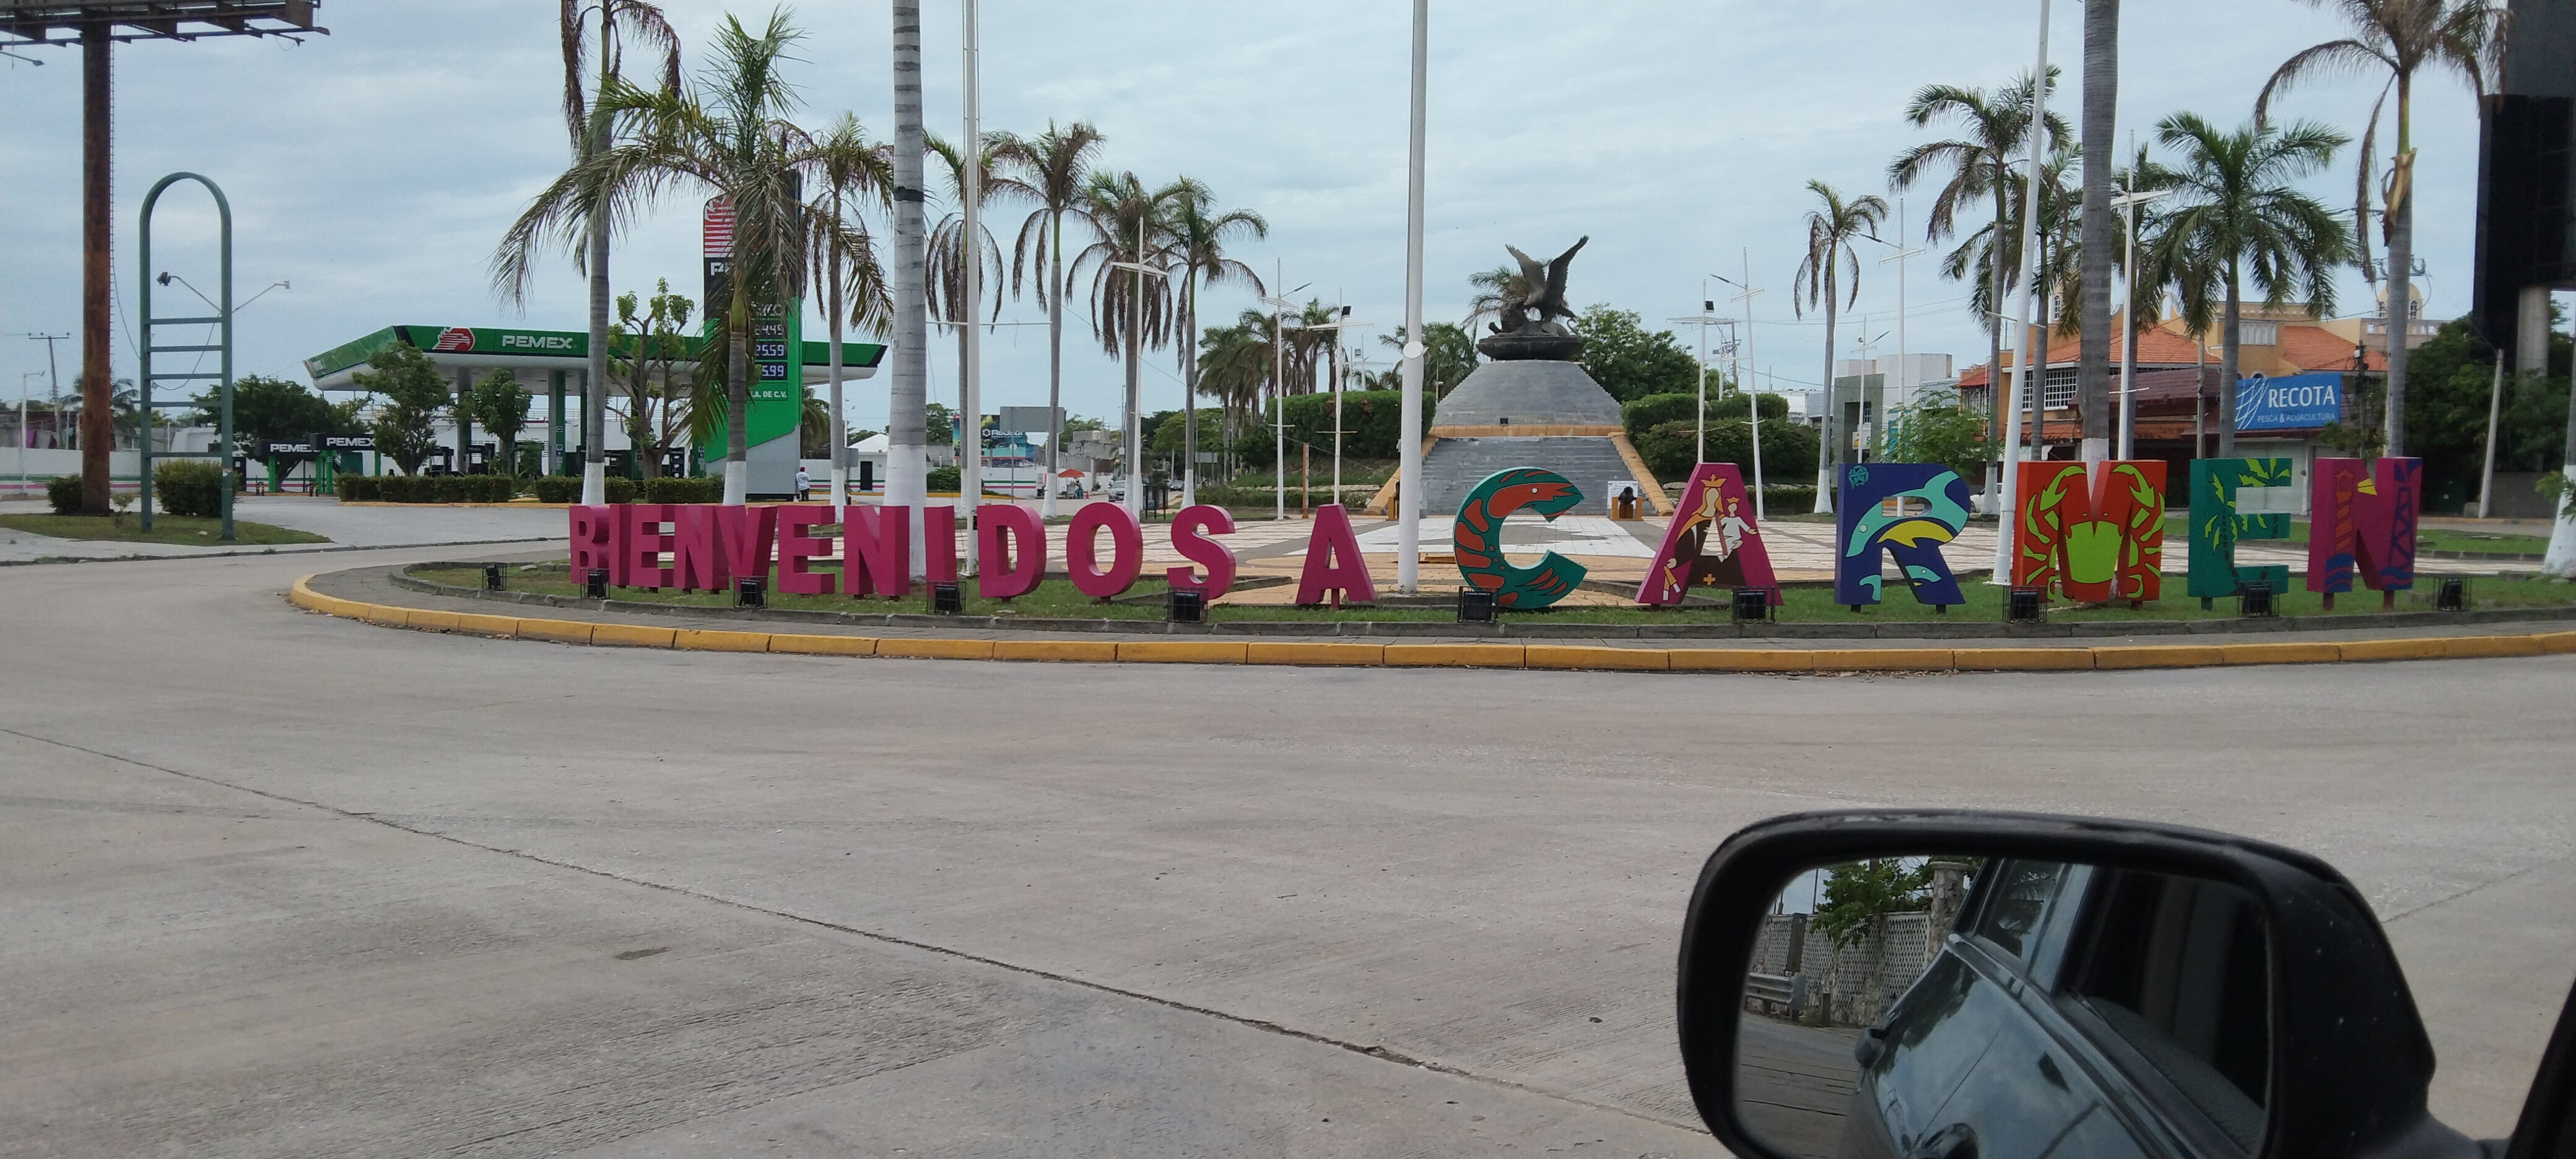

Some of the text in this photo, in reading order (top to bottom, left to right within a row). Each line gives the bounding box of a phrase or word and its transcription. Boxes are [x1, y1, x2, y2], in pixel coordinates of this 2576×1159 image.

[502, 335, 573, 349] PEMEX
[762, 365, 784, 376] 5.99
[2268, 385, 2335, 409] RECOTA
[2258, 415, 2279, 423] PESCA
[2279, 413, 2285, 423] &
[326, 437, 376, 446] PEMEX
[270, 443, 312, 453] PEME
[569, 457, 2422, 610] BIENVENIDOS A CARMEN
